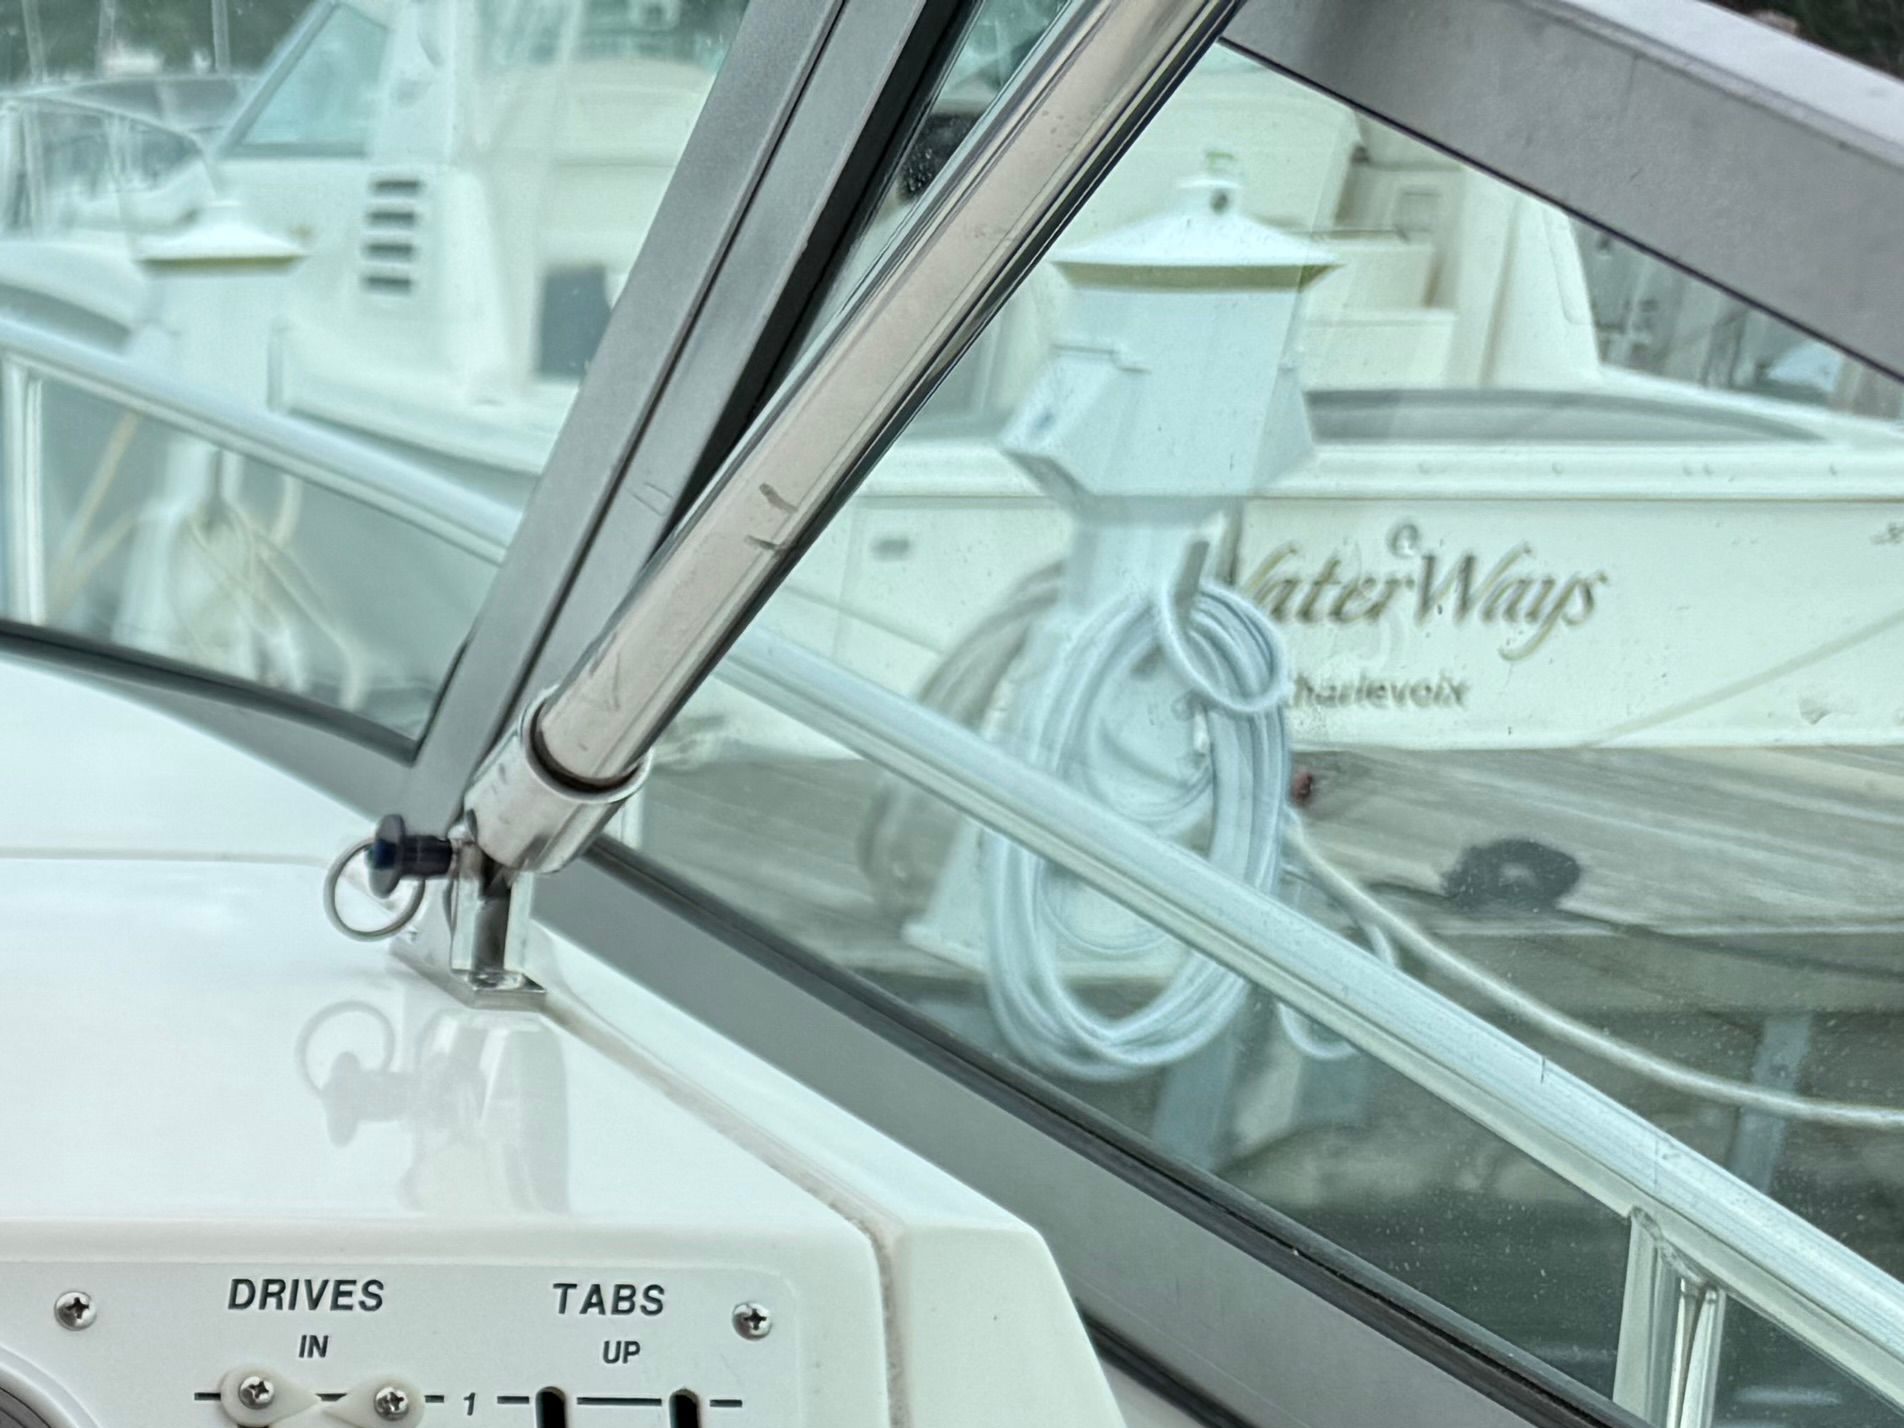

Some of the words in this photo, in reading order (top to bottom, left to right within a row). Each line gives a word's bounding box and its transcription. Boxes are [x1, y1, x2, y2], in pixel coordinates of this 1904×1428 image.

[1294, 670, 1468, 708] harlevoix
[227, 1277, 385, 1313] DRIVES
[552, 1282, 667, 1316] TABS
[298, 1333, 330, 1359] IN
[602, 1339, 642, 1365] UP
